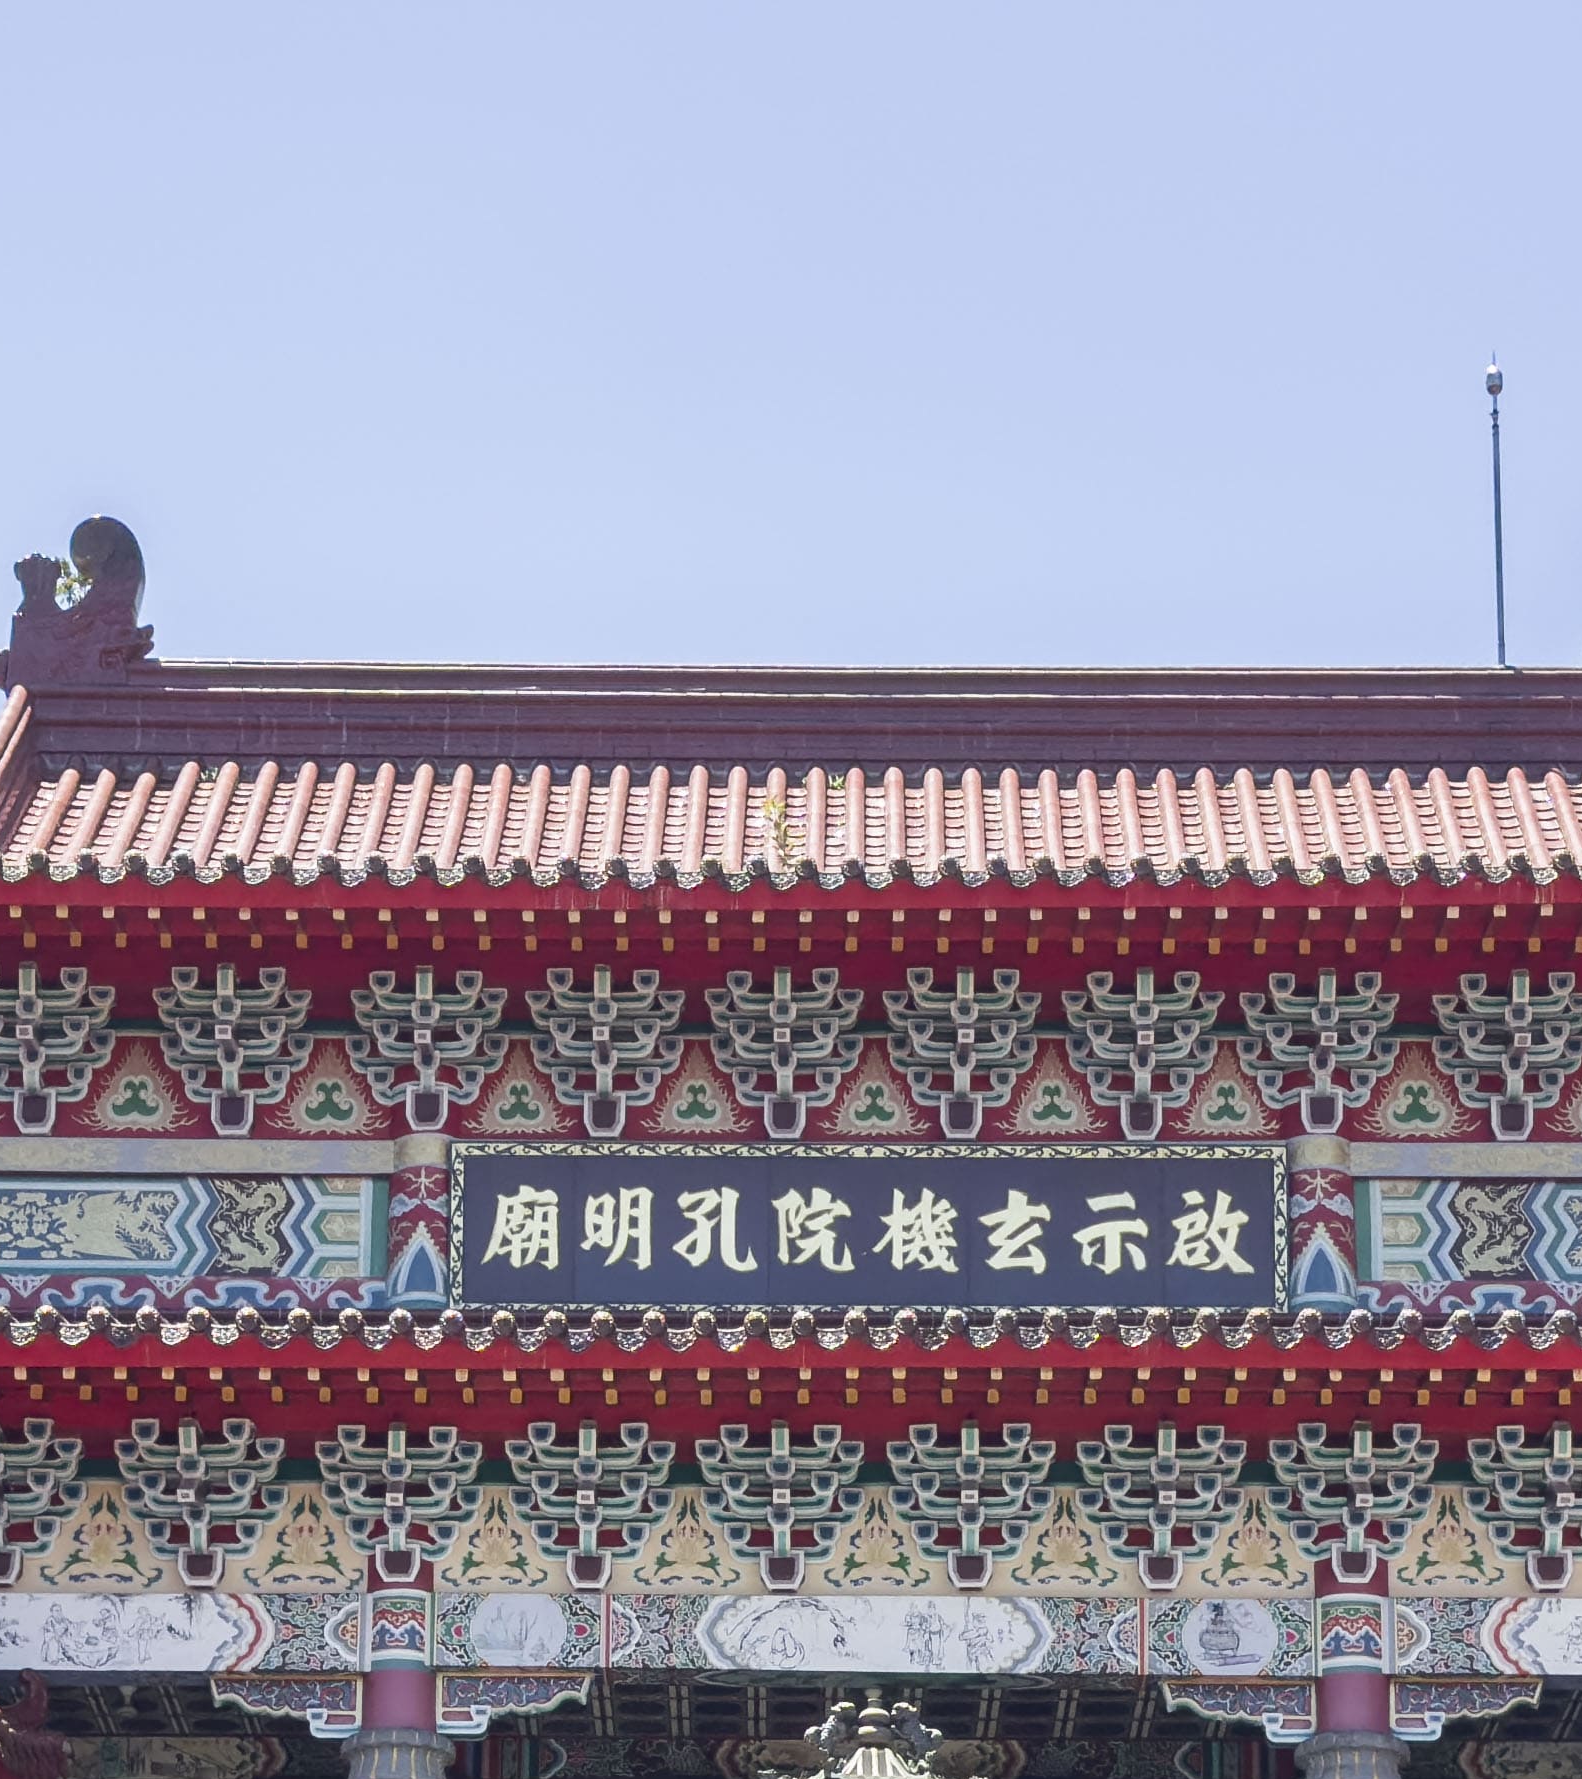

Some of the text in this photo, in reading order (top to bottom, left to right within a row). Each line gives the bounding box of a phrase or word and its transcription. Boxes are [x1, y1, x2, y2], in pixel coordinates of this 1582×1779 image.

[481, 1184, 1255, 1276] 啟示玄機院孔明廟
